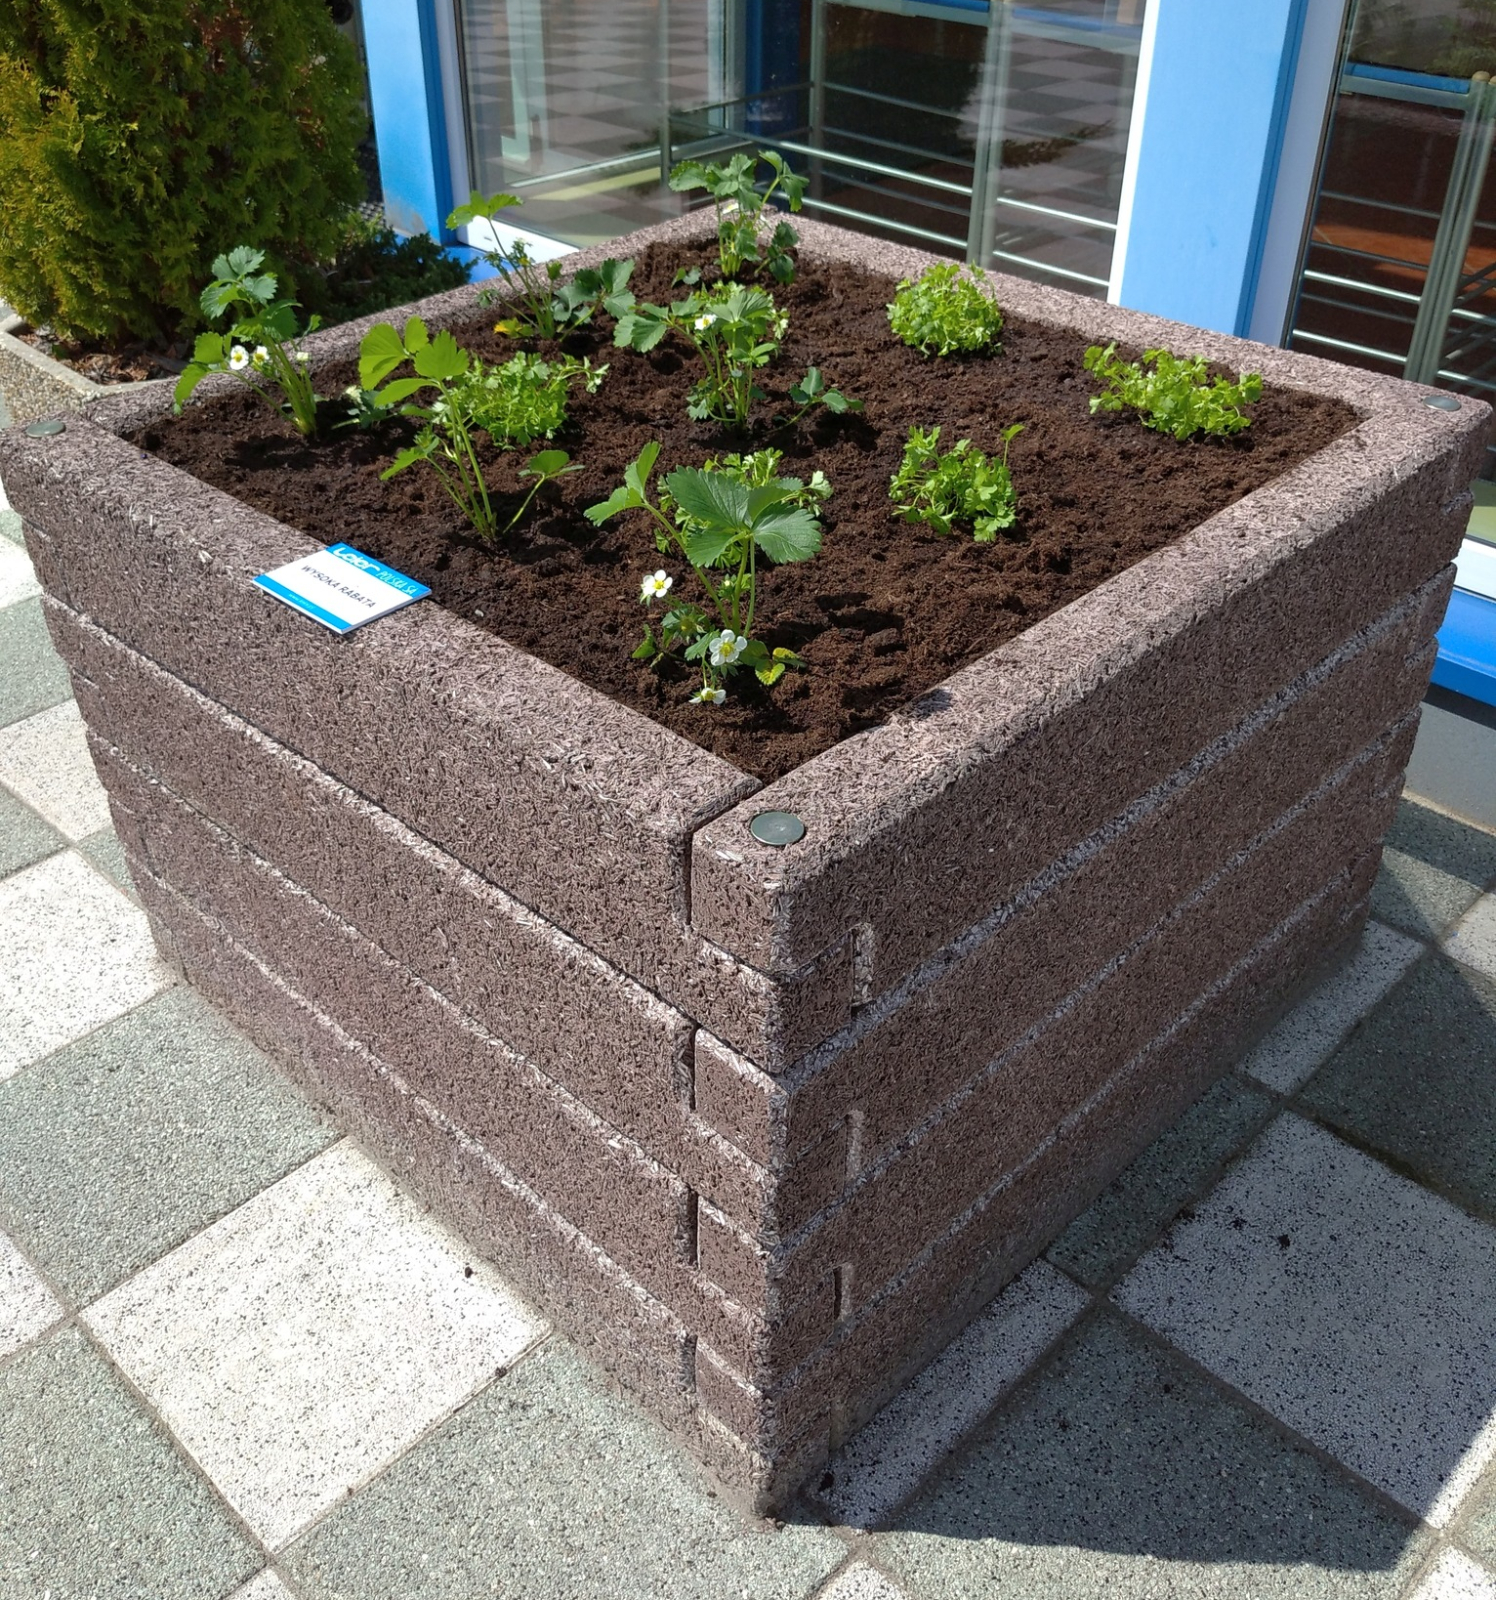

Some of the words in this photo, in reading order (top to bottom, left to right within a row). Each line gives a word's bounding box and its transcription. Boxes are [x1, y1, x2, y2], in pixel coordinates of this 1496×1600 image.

[301, 564, 341, 589] WYSOKA
[337, 585, 377, 608] RABATA
[376, 570, 408, 590] POLSKA
[403, 584, 419, 595] SA
